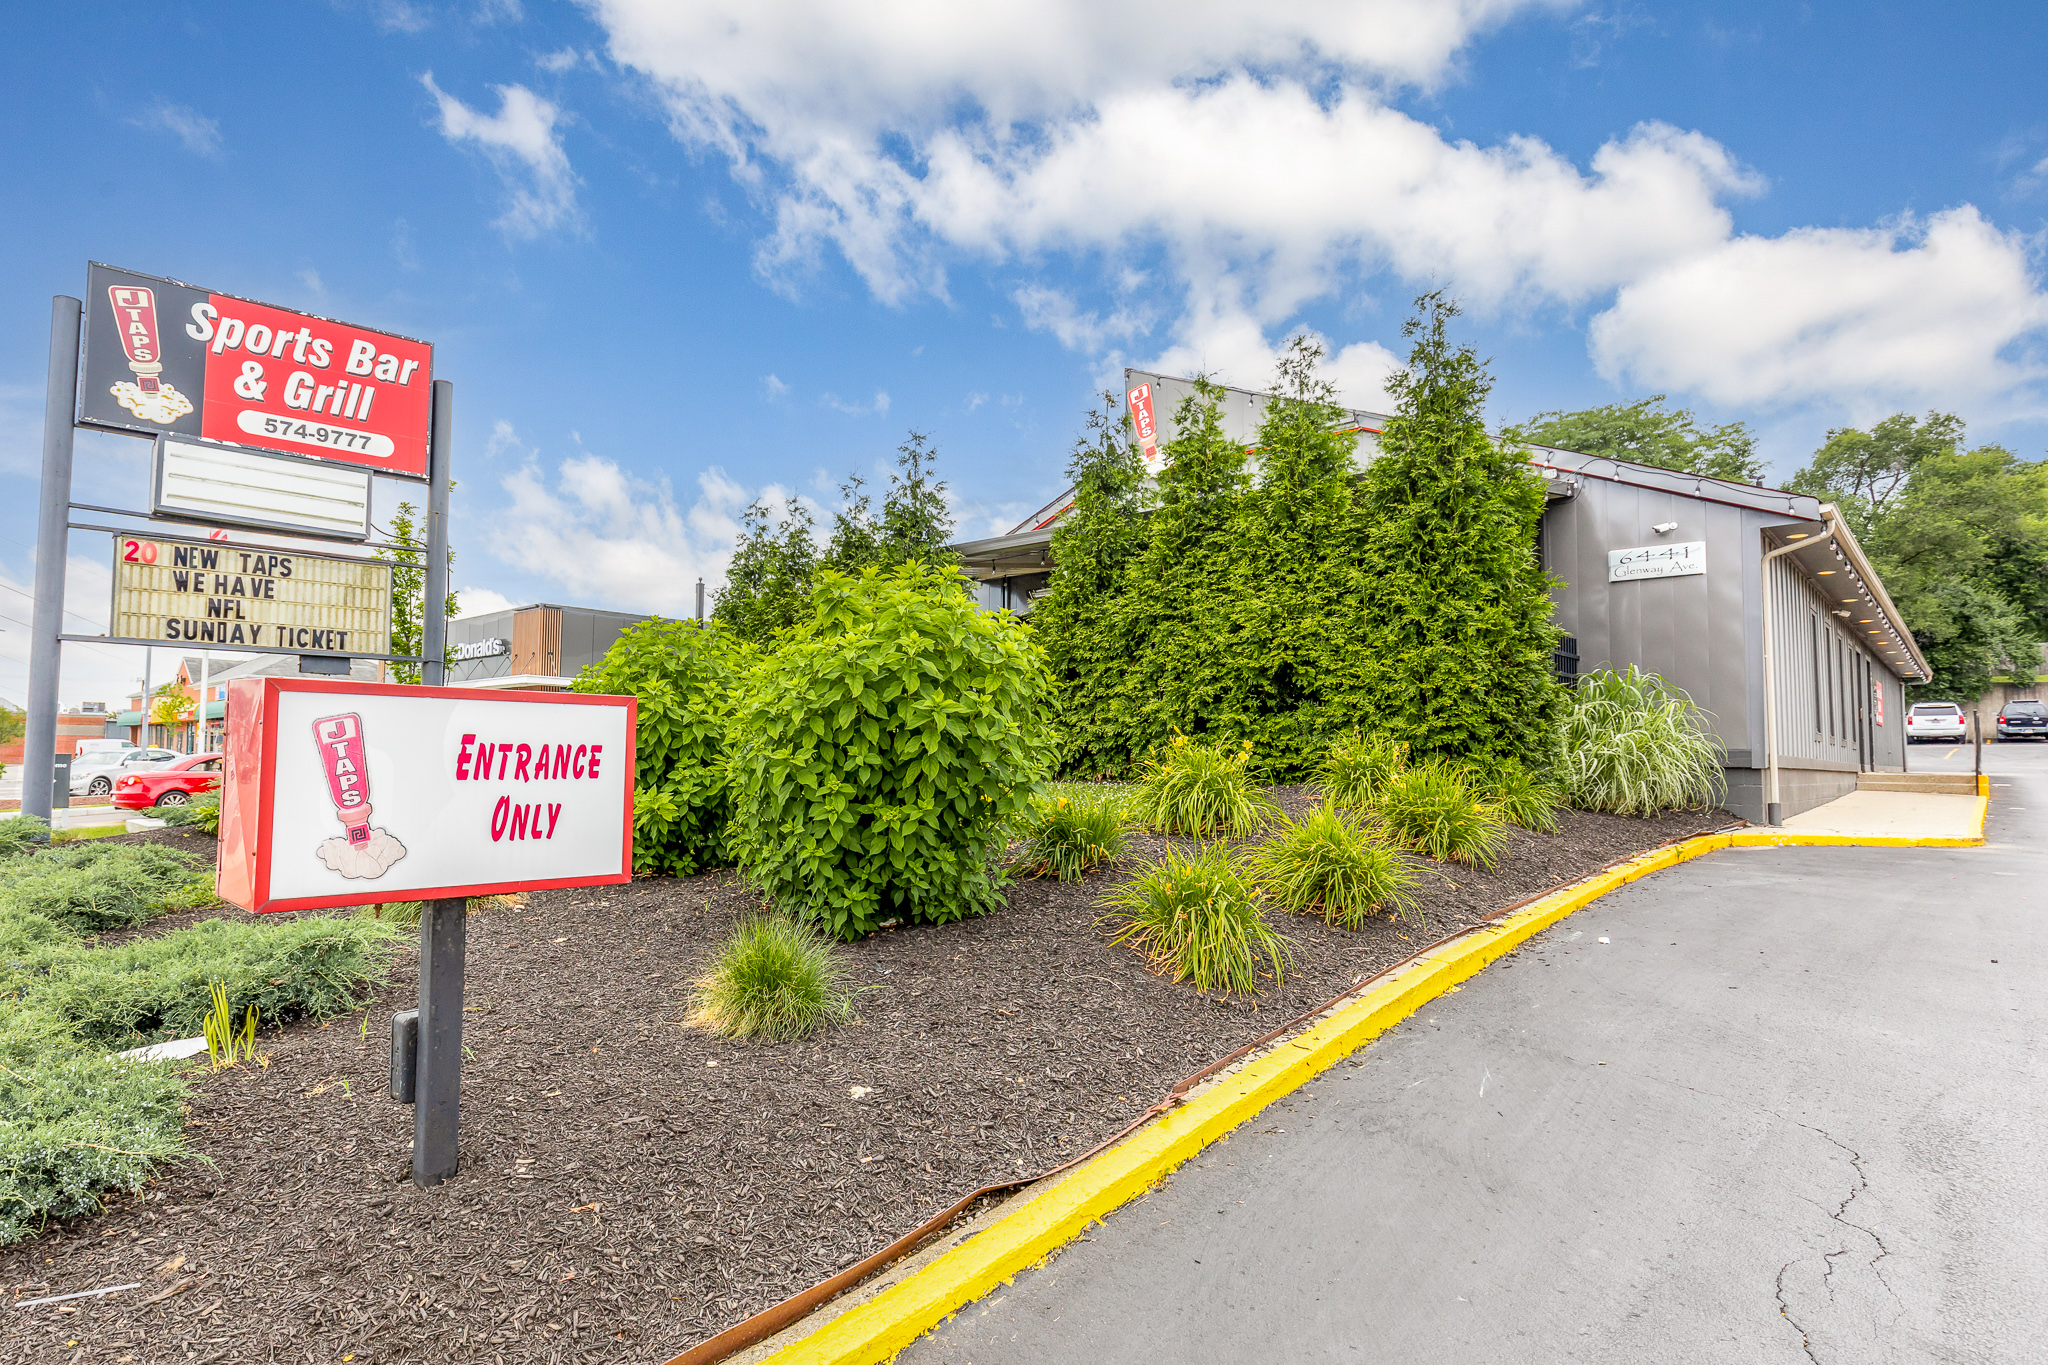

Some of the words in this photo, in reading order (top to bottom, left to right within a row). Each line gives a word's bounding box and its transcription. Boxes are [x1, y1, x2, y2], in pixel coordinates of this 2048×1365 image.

[122, 291, 140, 305] J
[126, 308, 153, 361] TAPS
[185, 302, 333, 368] Sports
[346, 338, 419, 386] Bar
[233, 360, 268, 403] &
[283, 370, 376, 422] Grill
[264, 417, 372, 451] 574-9777
[1137, 401, 1152, 437] TAPS
[123, 540, 158, 565] 20
[173, 546, 219, 570] NEW
[239, 553, 292, 577] TAPS
[1614, 566, 1664, 578] Glenway
[1670, 561, 1698, 573] Ave.
[1620, 546, 1689, 565] 6441
[172, 570, 205, 593] WE
[214, 574, 275, 599] HAVE
[208, 597, 246, 620] NFL
[166, 618, 262, 645] SUNDAY
[277, 626, 348, 651] TICKET
[327, 721, 347, 740] J
[332, 741, 362, 806] TAPS
[455, 733, 603, 783] ENTRANCE
[491, 795, 562, 842] ONLY
